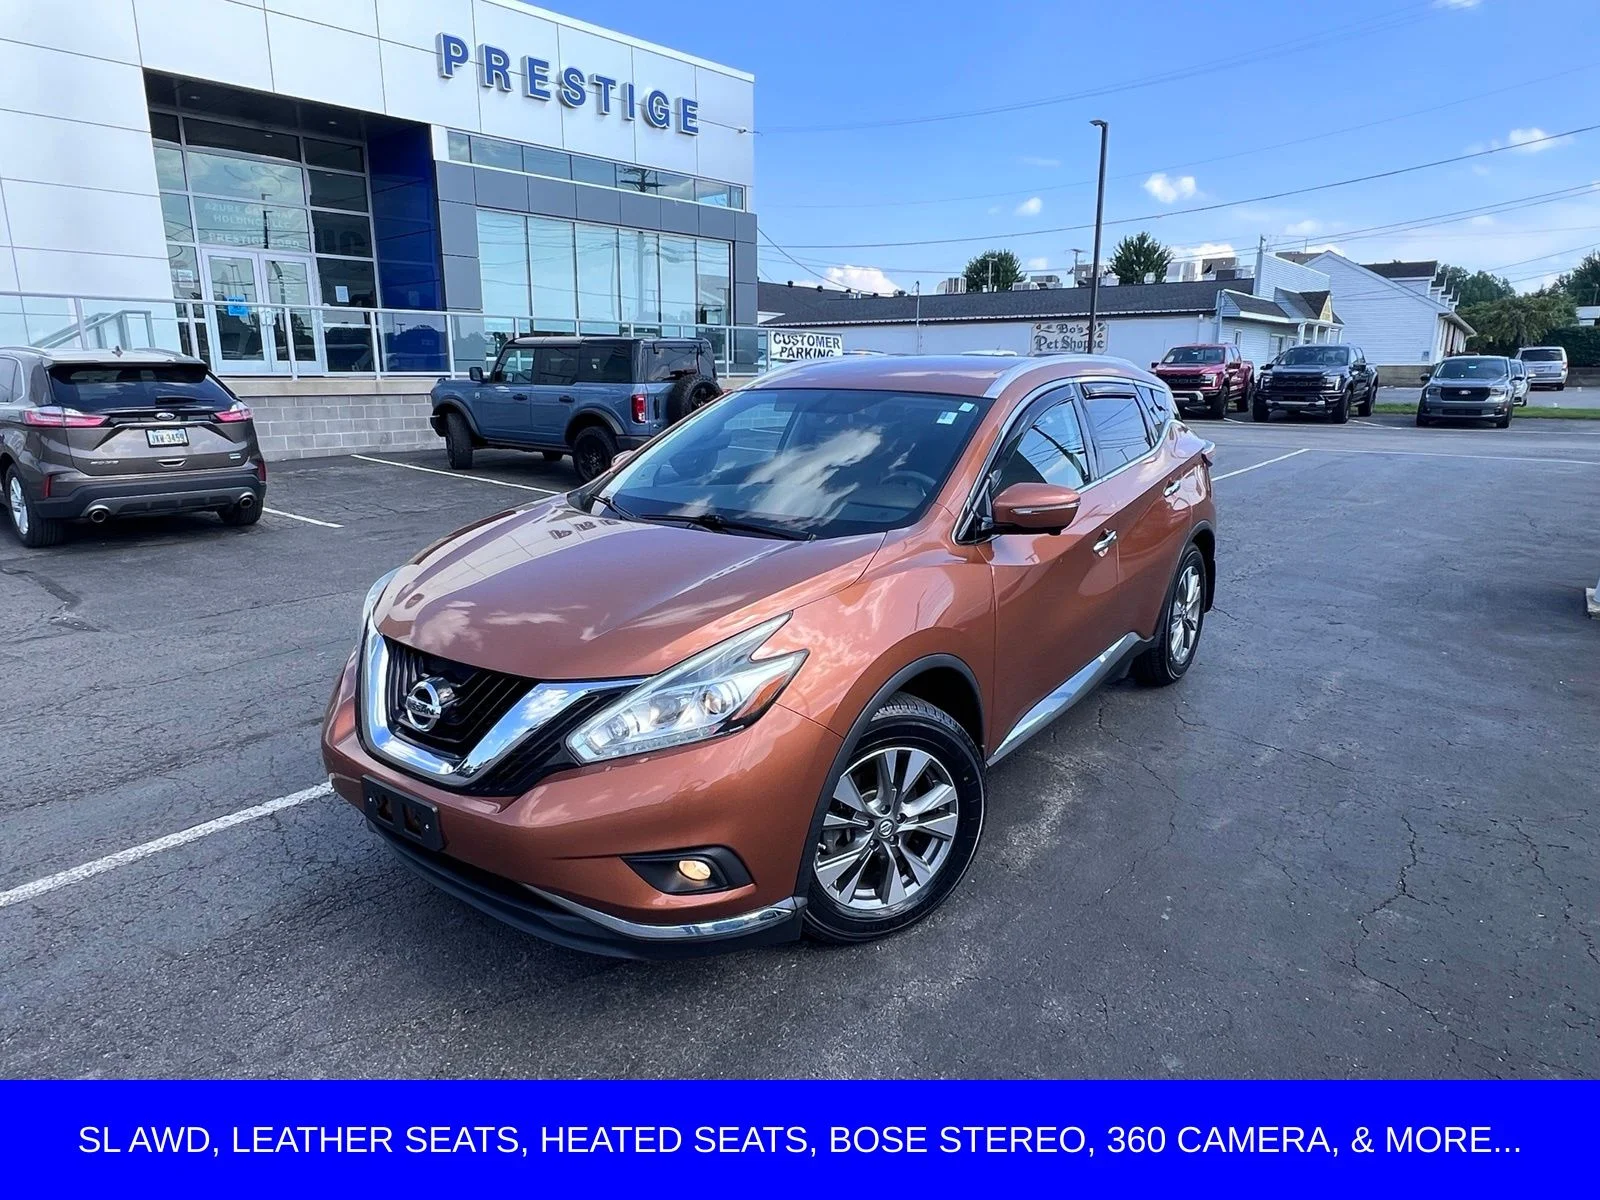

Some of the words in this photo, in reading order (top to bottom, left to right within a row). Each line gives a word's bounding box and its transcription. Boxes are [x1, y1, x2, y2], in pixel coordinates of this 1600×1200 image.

[435, 32, 699, 136] PRESTIGE
[213, 214, 267, 226] HOLDING
[1056, 323, 1084, 334] Bo's
[773, 332, 841, 350] CUSTOMER
[1034, 335, 1060, 351] Pet
[779, 346, 835, 360] PARKING
